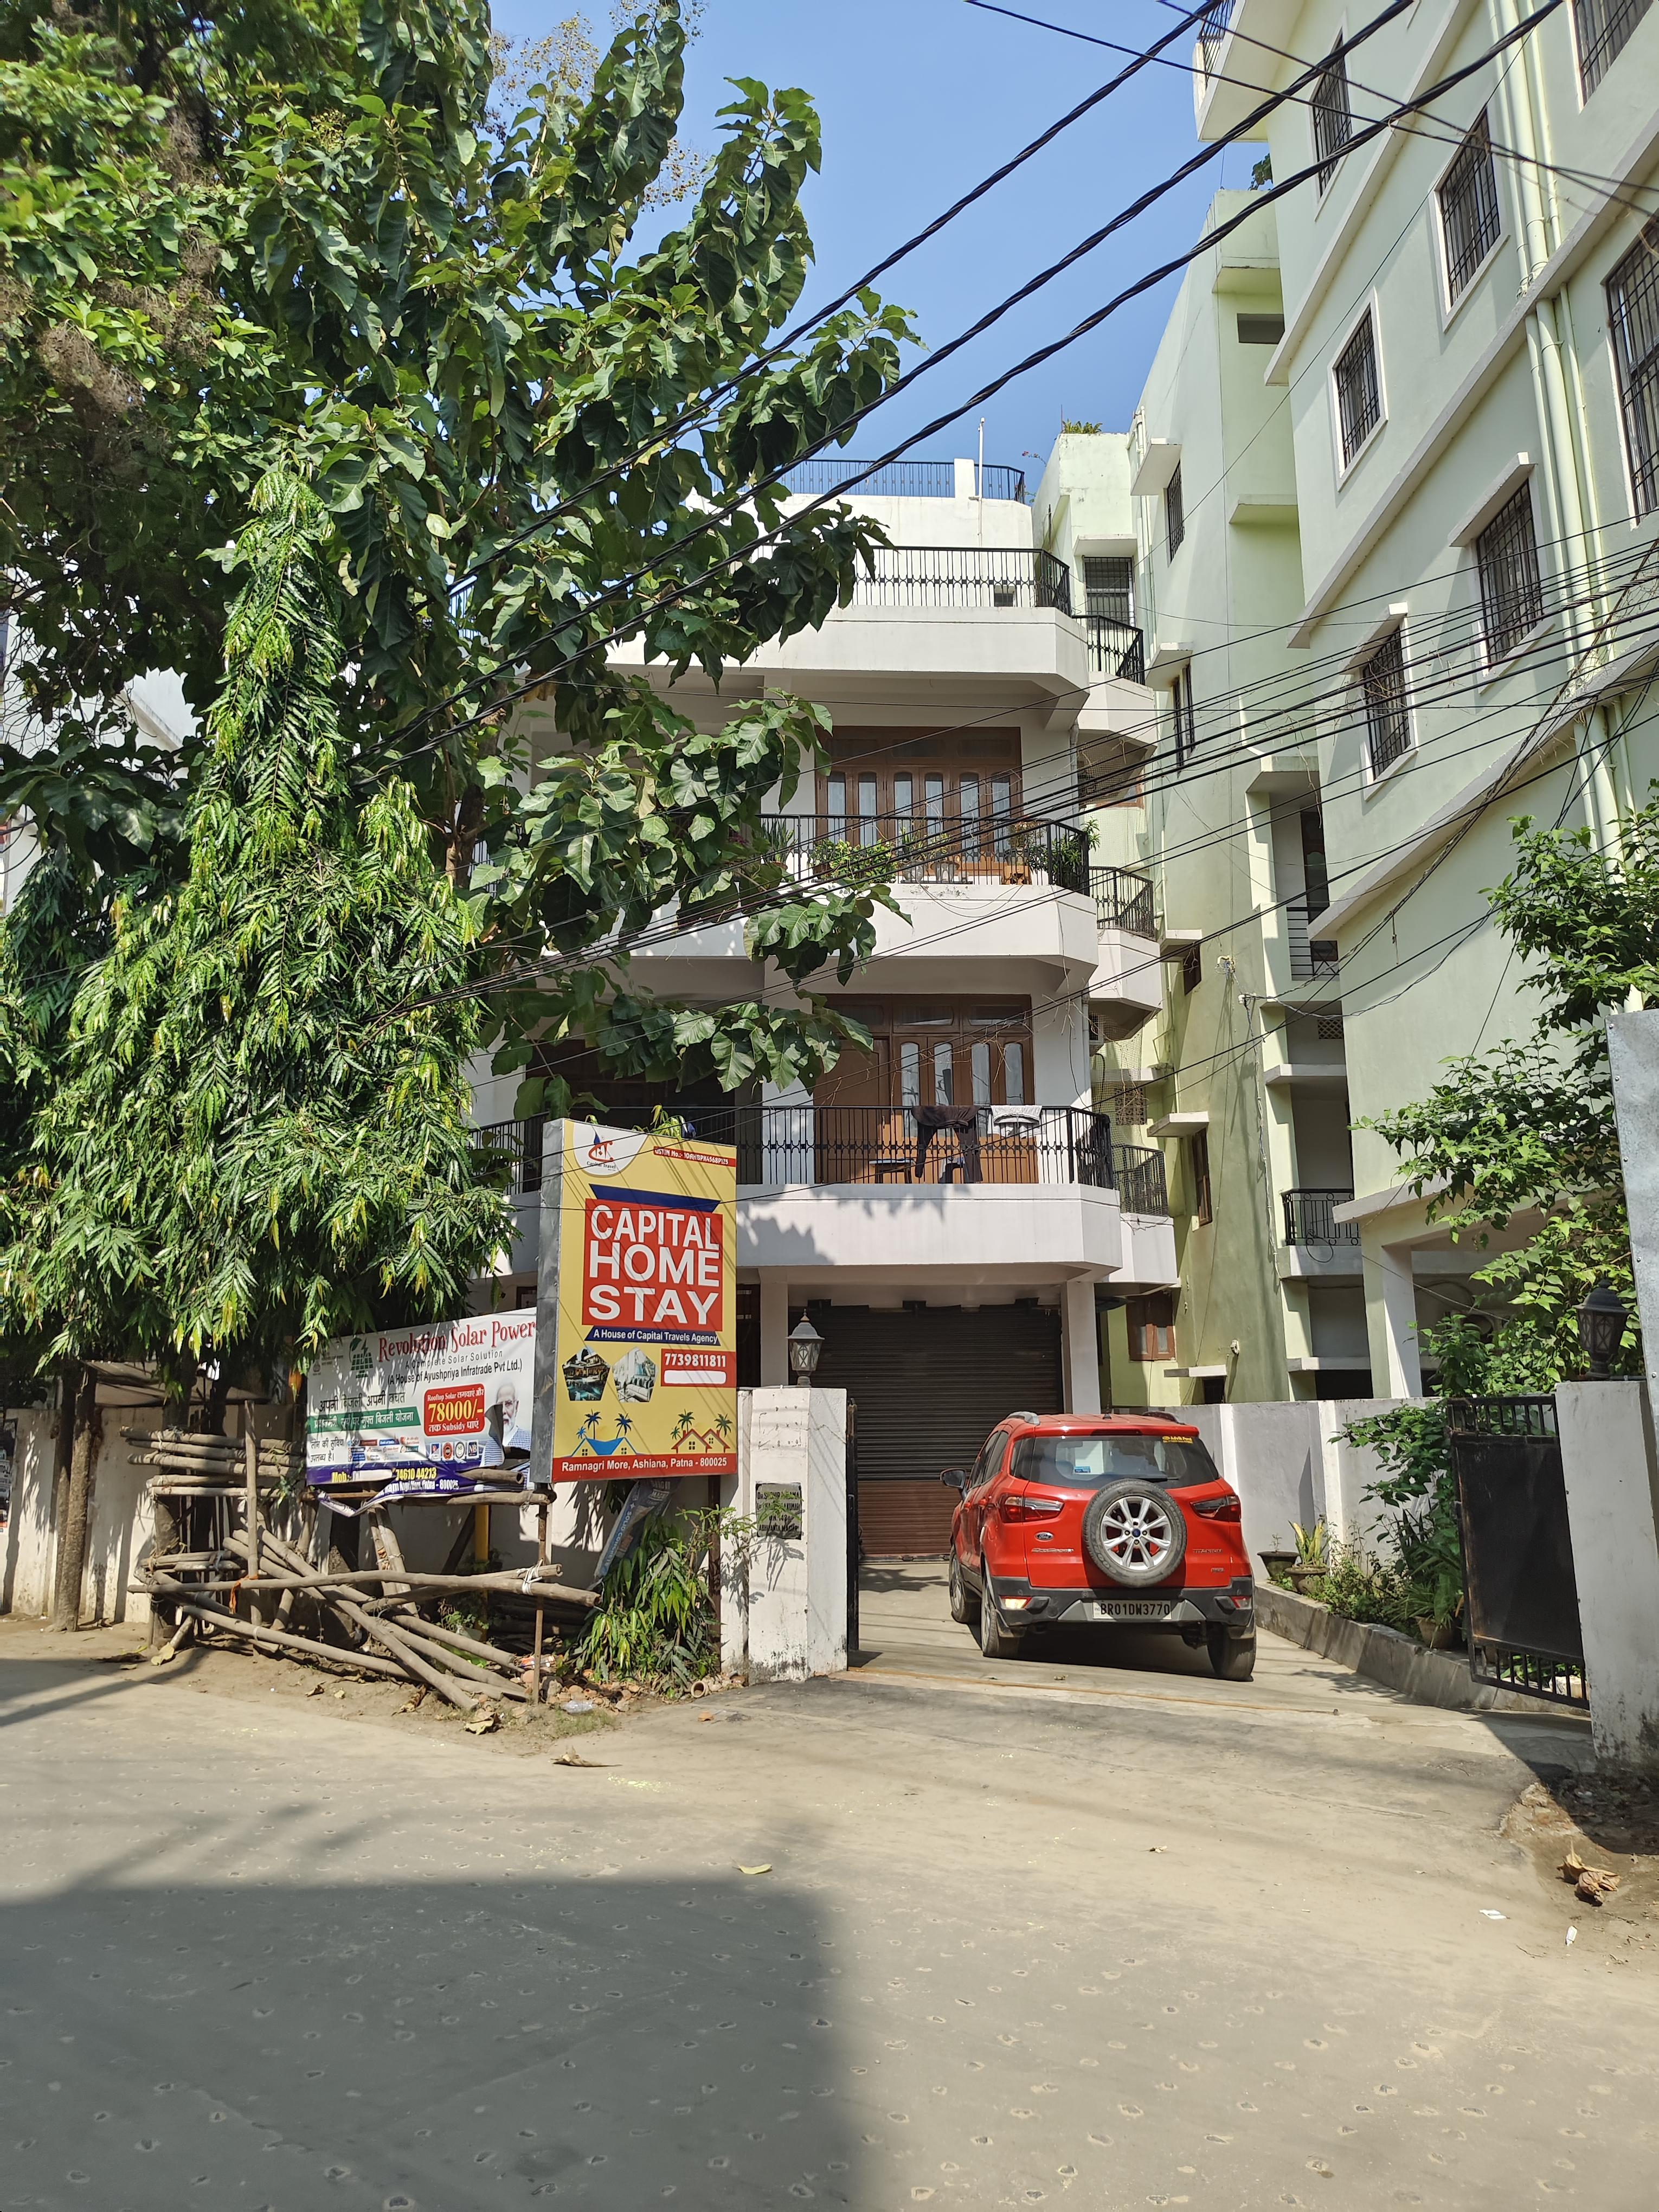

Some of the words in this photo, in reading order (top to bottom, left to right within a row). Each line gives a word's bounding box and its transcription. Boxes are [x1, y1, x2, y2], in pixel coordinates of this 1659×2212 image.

[654, 1148, 670, 1156] GSTIN
[591, 1205, 719, 1251] CAPITAL
[589, 1240, 719, 1287] HOME
[588, 1284, 719, 1324] STAY
[378, 1331, 446, 1362] Revolution
[451, 1324, 487, 1353] Solar
[491, 1321, 536, 1348] Power
[594, 1329, 600, 1338] A
[601, 1330, 625, 1339] House
[627, 1330, 635, 1339] of
[637, 1330, 663, 1341] Capital
[664, 1332, 690, 1341] Travels
[691, 1333, 718, 1345] Agency
[412, 1358, 446, 1369] Complete
[448, 1355, 468, 1365] Solar
[470, 1350, 503, 1361] Solution
[665, 1353, 726, 1367] 7739811811
[388, 1375, 394, 1387] (A
[396, 1373, 415, 1384] House
[416, 1372, 423, 1382] of
[424, 1368, 459, 1381] Ayushpriya
[461, 1364, 492, 1377] Infratrade
[494, 1362, 505, 1373] Pvt
[506, 1358, 523, 1372] Ltd.)
[319, 1396, 338, 1412] अपनी
[341, 1393, 362, 1409] बिजली
[366, 1390, 385, 1406] अपनी
[389, 1392, 406, 1404] बचत
[427, 1393, 444, 1401] Rooftop
[475, 1387, 484, 1396] और
[376, 1410, 394, 1423] बिजली
[395, 1410, 414, 1422] योजना
[428, 1399, 483, 1423] 78000/-
[428, 1424, 441, 1432] तक
[442, 1422, 466, 1431] Subsidy
[467, 1418, 479, 1429] पाएं
[322, 1438, 329, 1448] की
[562, 1461, 605, 1472] Ramnagri
[607, 1459, 631, 1471] More,
[633, 1458, 668, 1469] Ashiana,
[671, 1458, 693, 1468] Patna
[700, 1457, 727, 1467] 800025
[396, 1468, 414, 1481] 74610
[416, 1467, 436, 1479] 44213
[422, 1480, 435, 1490] Patna
[439, 1479, 459, 1490] 800025
[621, 1510, 632, 1532] SOLID
